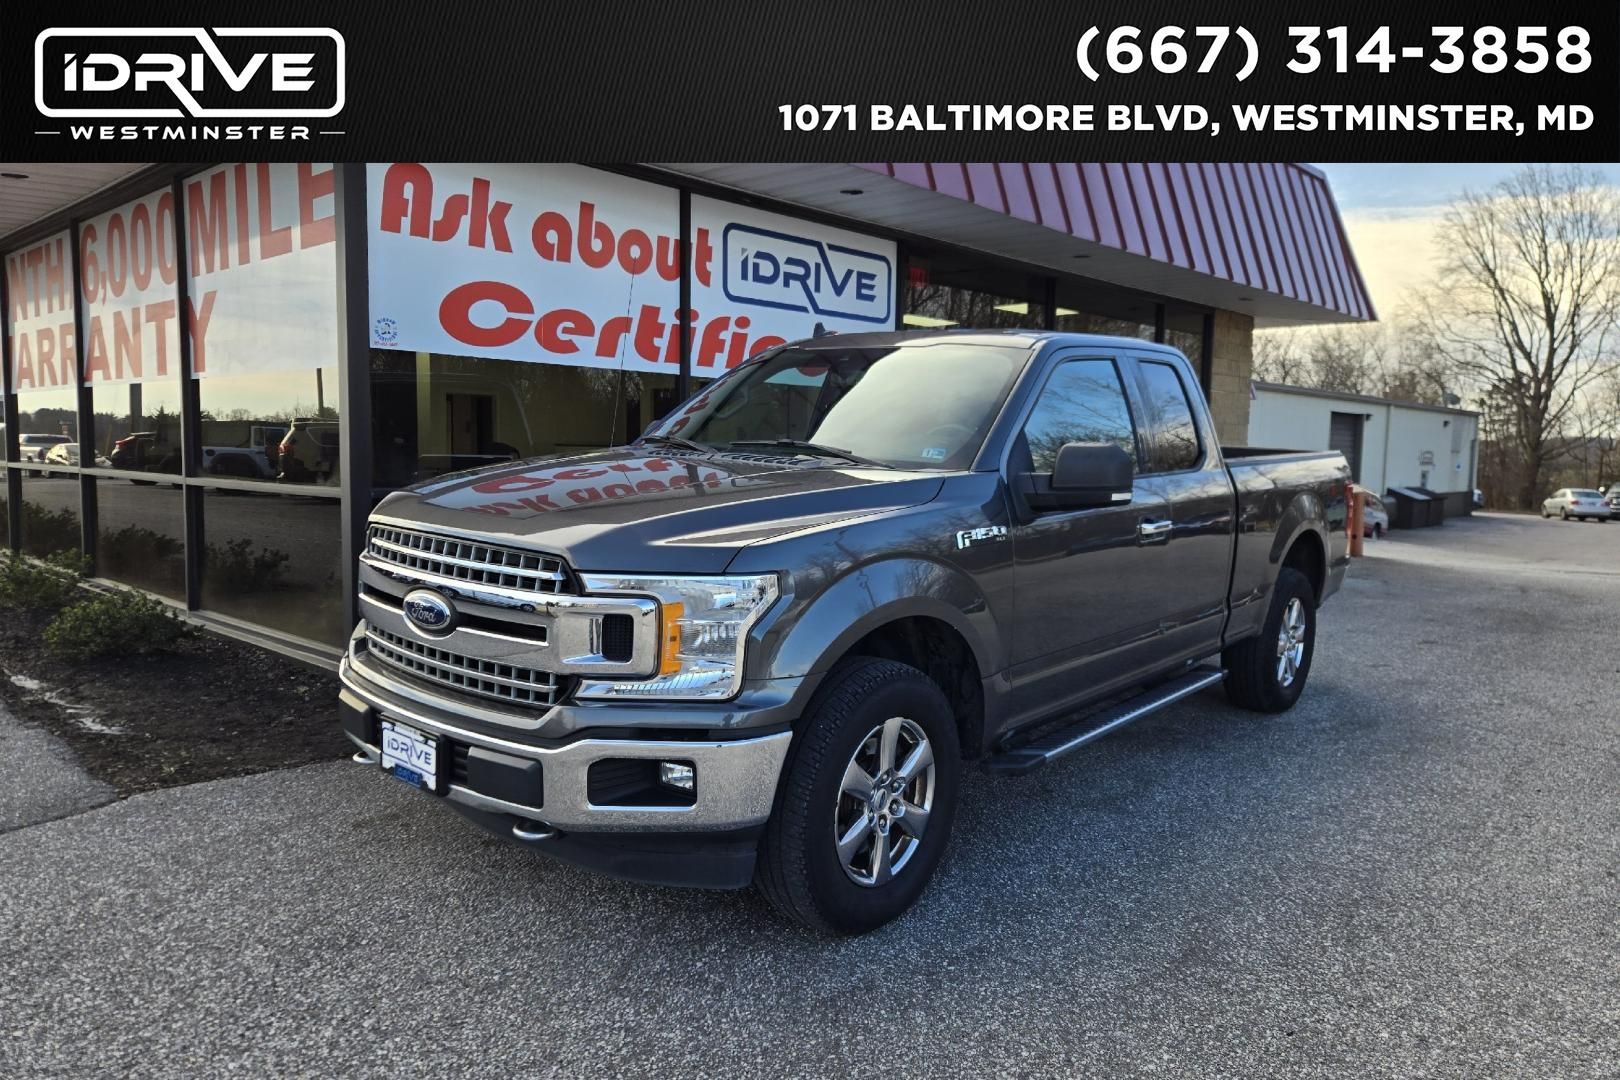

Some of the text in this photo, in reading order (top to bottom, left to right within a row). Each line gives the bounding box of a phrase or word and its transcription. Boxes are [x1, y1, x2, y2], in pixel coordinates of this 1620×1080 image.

[80, 192, 177, 305] 6,000
[380, 163, 713, 288] Ask about
[9, 291, 217, 389] ARRANTY
[411, 603, 437, 623] Ford
